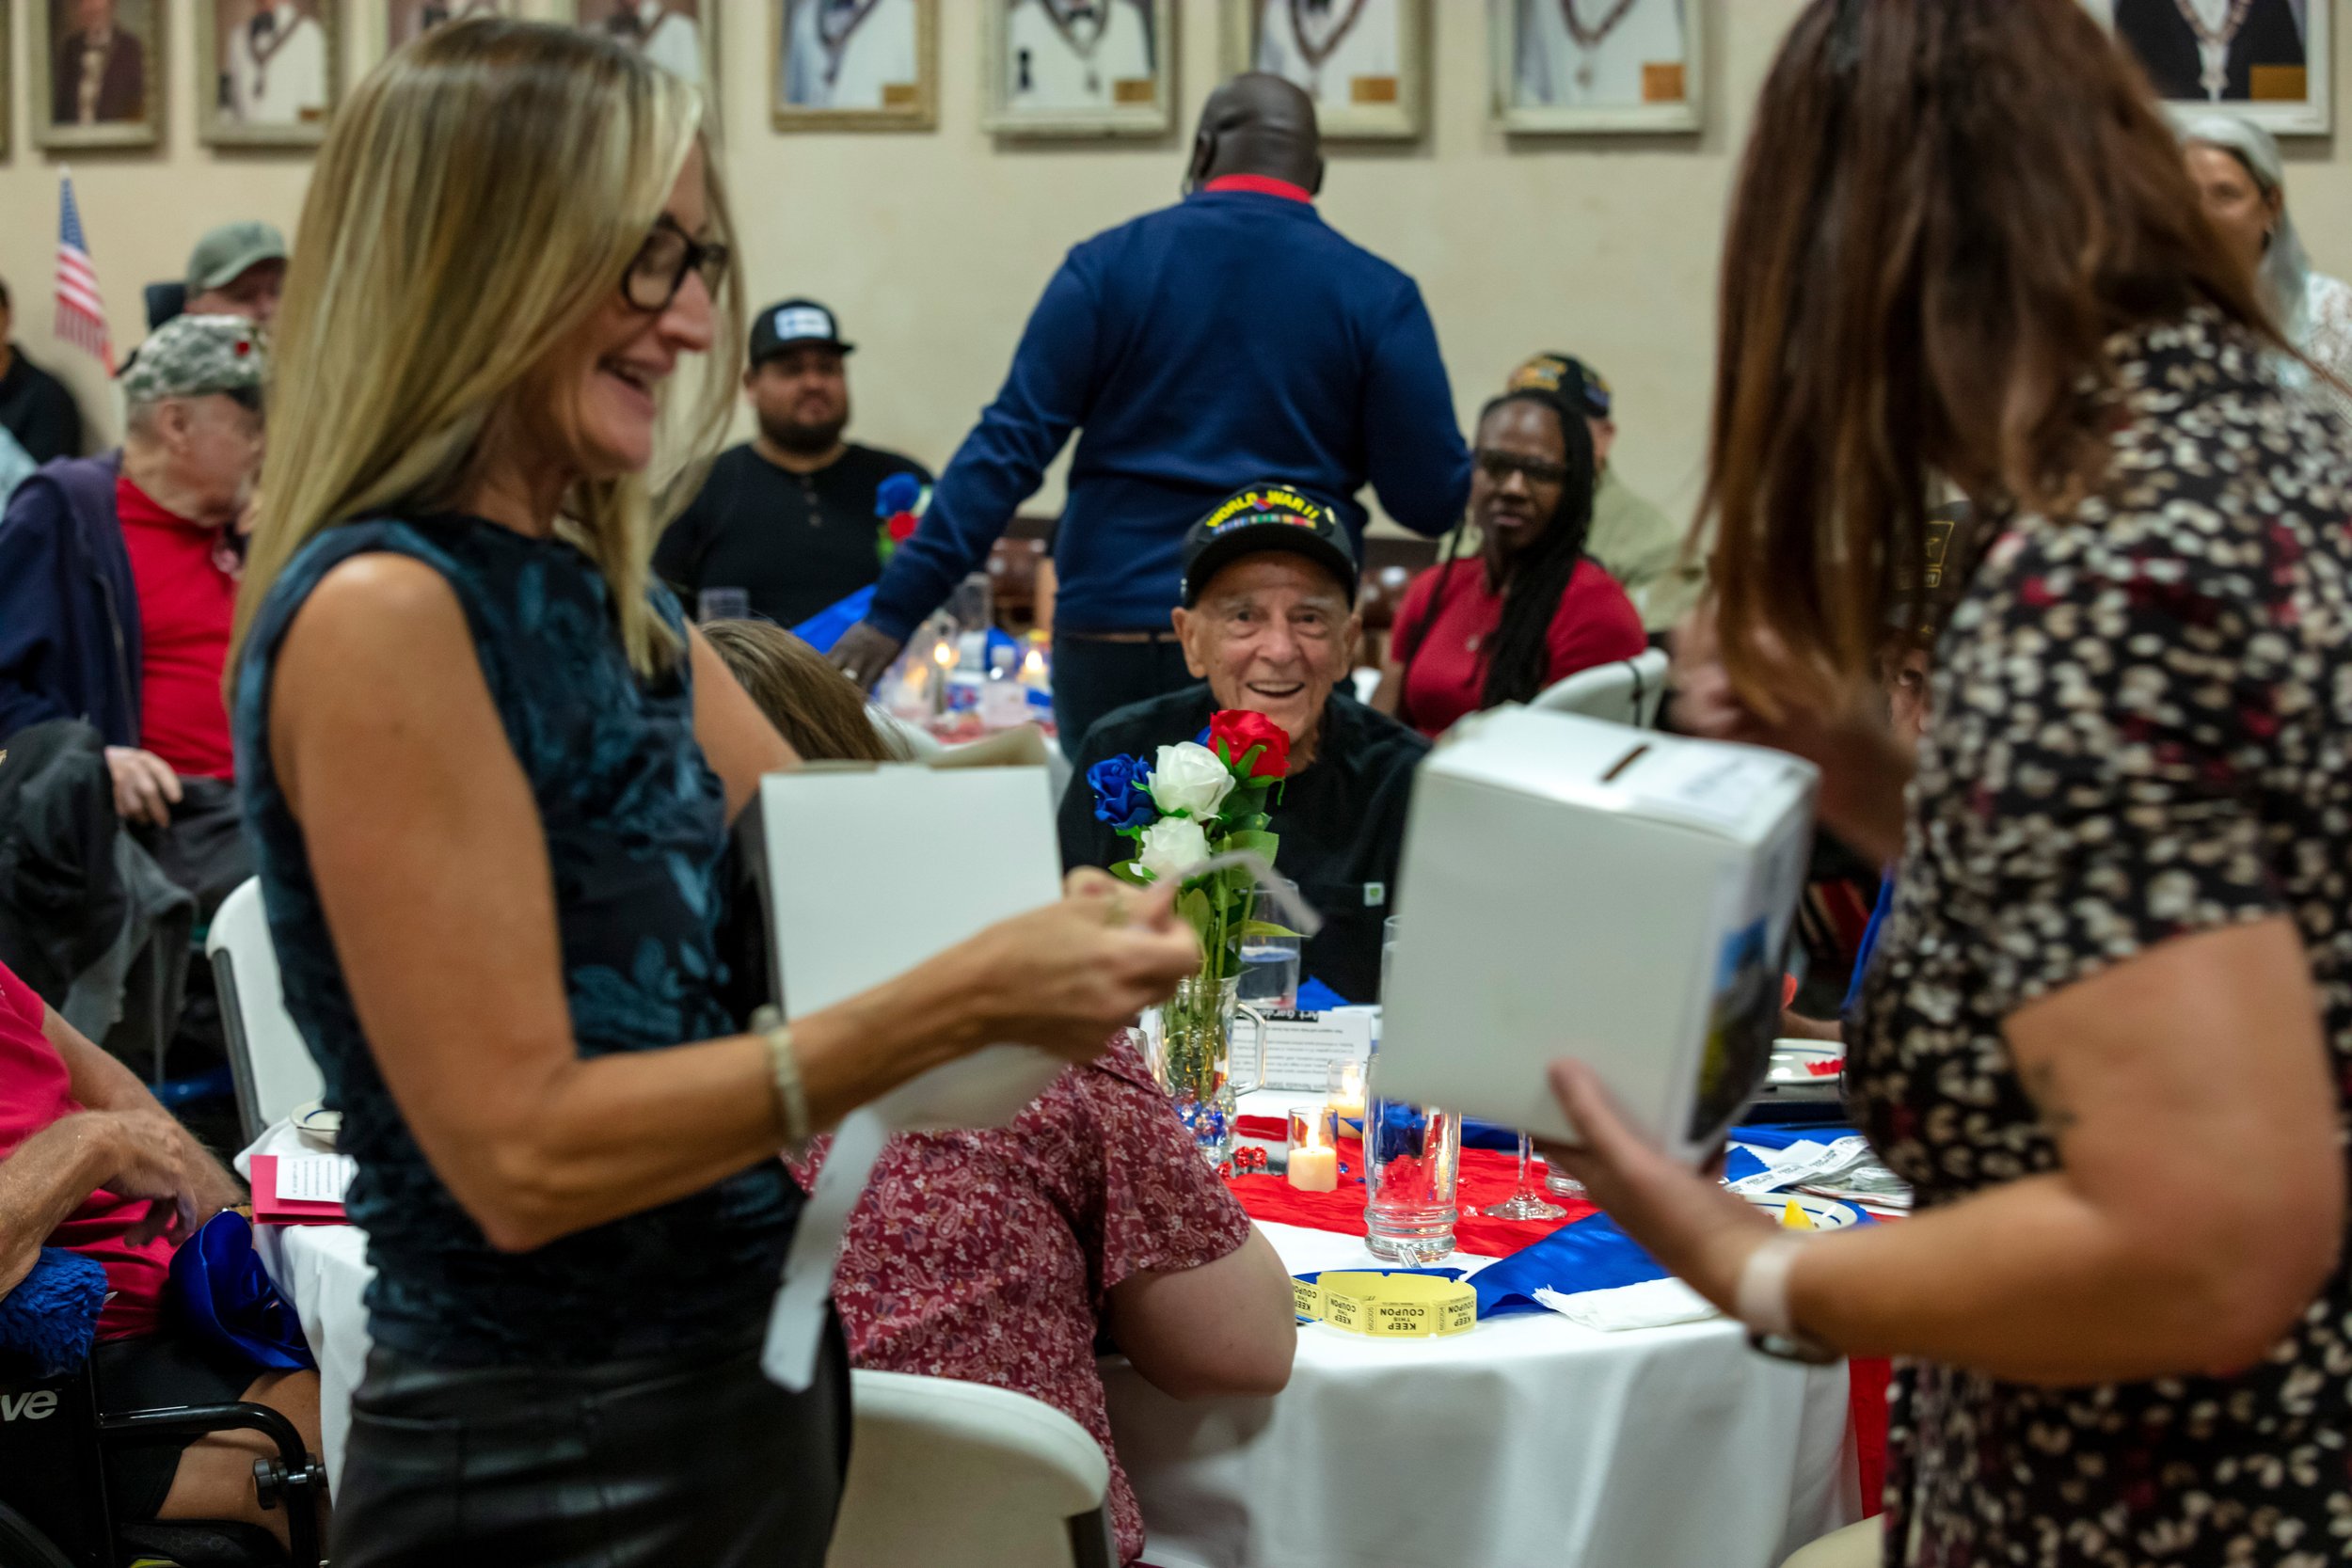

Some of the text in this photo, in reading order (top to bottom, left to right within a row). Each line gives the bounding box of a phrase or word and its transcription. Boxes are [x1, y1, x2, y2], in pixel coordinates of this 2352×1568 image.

[1206, 489, 1320, 527] WORLD WAR II
[1258, 1008, 1318, 1021] Art Garde
[1295, 1286, 1317, 1299] COUPO
[1330, 1299, 1356, 1313] COUPON
[1380, 1308, 1424, 1317] COUPON
[1448, 1301, 1474, 1314] COUPON
[1334, 1314, 1352, 1325] KEEP
[1454, 1317, 1470, 1327] KEEP
[1388, 1323, 1416, 1331] KEEP
